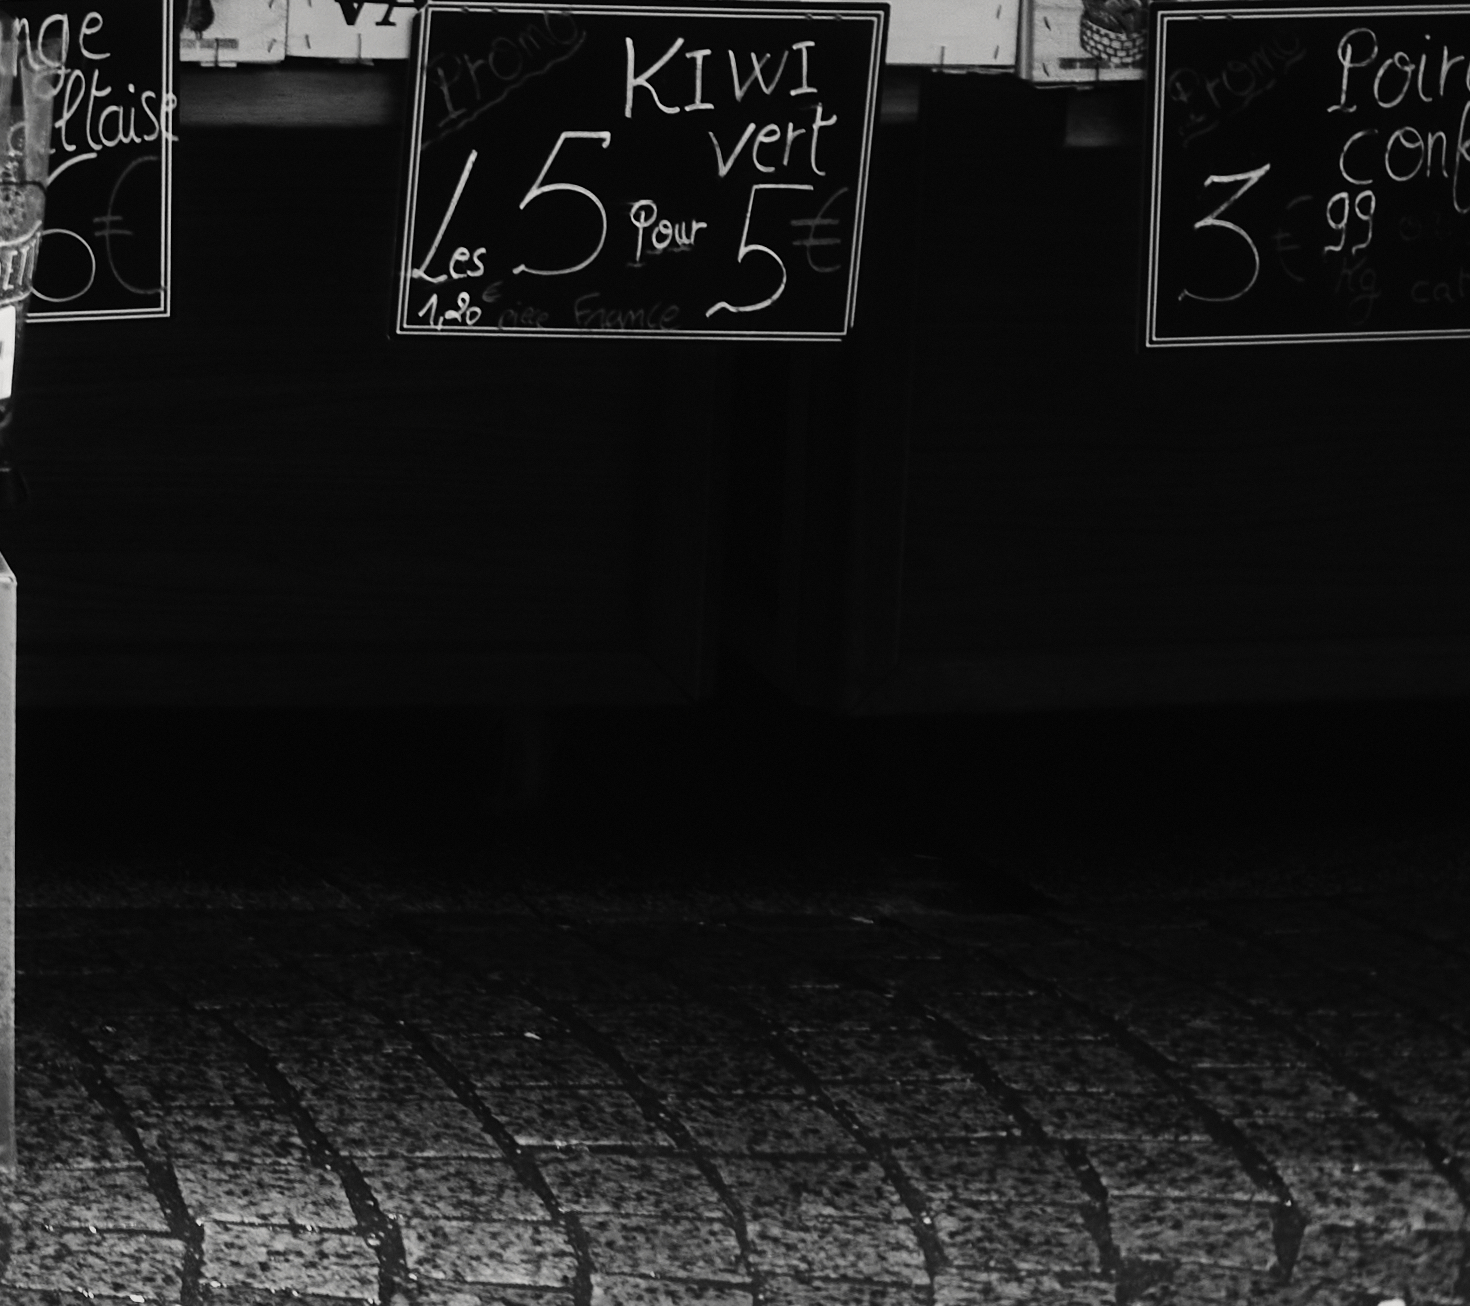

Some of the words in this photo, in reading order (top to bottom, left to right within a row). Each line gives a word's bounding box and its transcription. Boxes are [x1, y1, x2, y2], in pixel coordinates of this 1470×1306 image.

[624, 35, 822, 118] KIWI
[1324, 26, 1470, 115] Poir
[707, 104, 839, 179] vert
[512, 130, 612, 276] 5
[628, 199, 708, 265] Pour
[1176, 161, 1274, 305] 3
